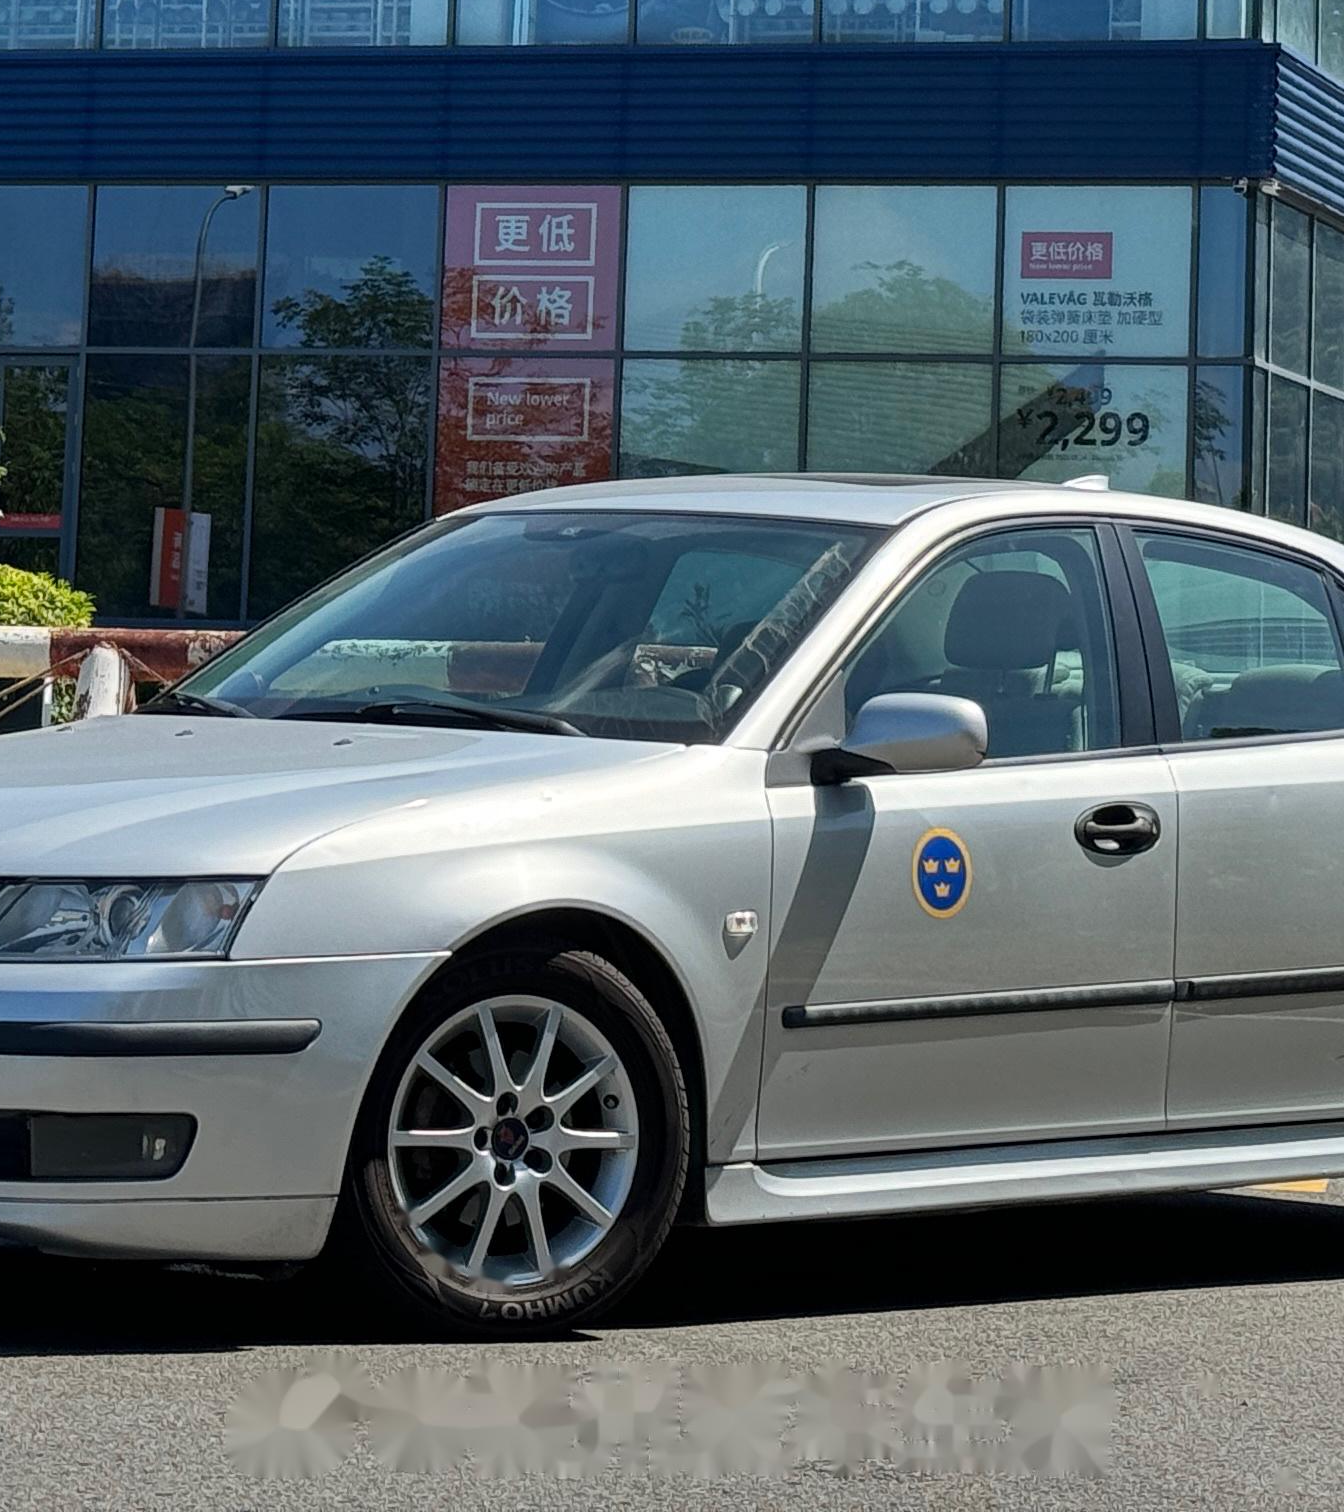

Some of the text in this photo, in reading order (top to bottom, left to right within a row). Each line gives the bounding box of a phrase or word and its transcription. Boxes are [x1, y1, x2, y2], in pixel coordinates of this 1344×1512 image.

[494, 214, 576, 253] 更低
[1029, 241, 1104, 262] 更低价格
[492, 285, 573, 326] 价格
[1020, 290, 1088, 306] VALEVÅG
[487, 390, 570, 406] New lower
[485, 411, 525, 429] price
